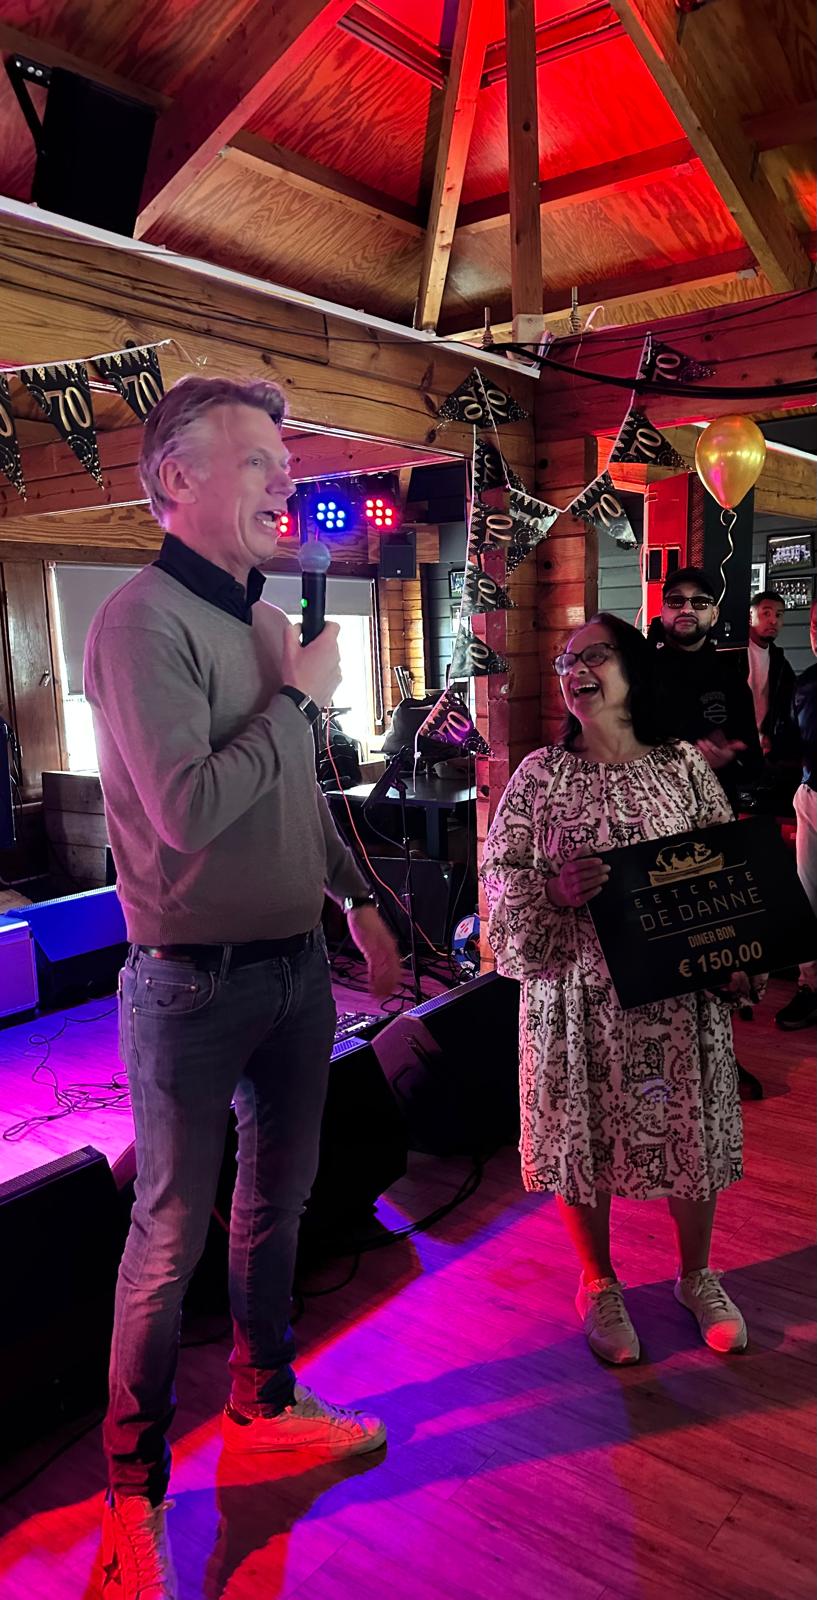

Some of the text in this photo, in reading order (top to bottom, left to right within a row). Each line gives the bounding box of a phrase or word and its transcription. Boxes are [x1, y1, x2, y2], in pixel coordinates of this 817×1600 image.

[651, 353, 681, 382] 70
[121, 371, 163, 414] 70
[458, 386, 483, 420] 70
[44, 386, 91, 432] 70
[628, 428, 662, 459] 70
[586, 494, 622, 527] 70
[485, 513, 514, 544] 70
[475, 578, 497, 606] 70
[438, 711, 470, 741] 70
[640, 886, 764, 932] DE DANNE
[687, 925, 736, 948] DINER BON
[678, 940, 764, 978] € 150,00
